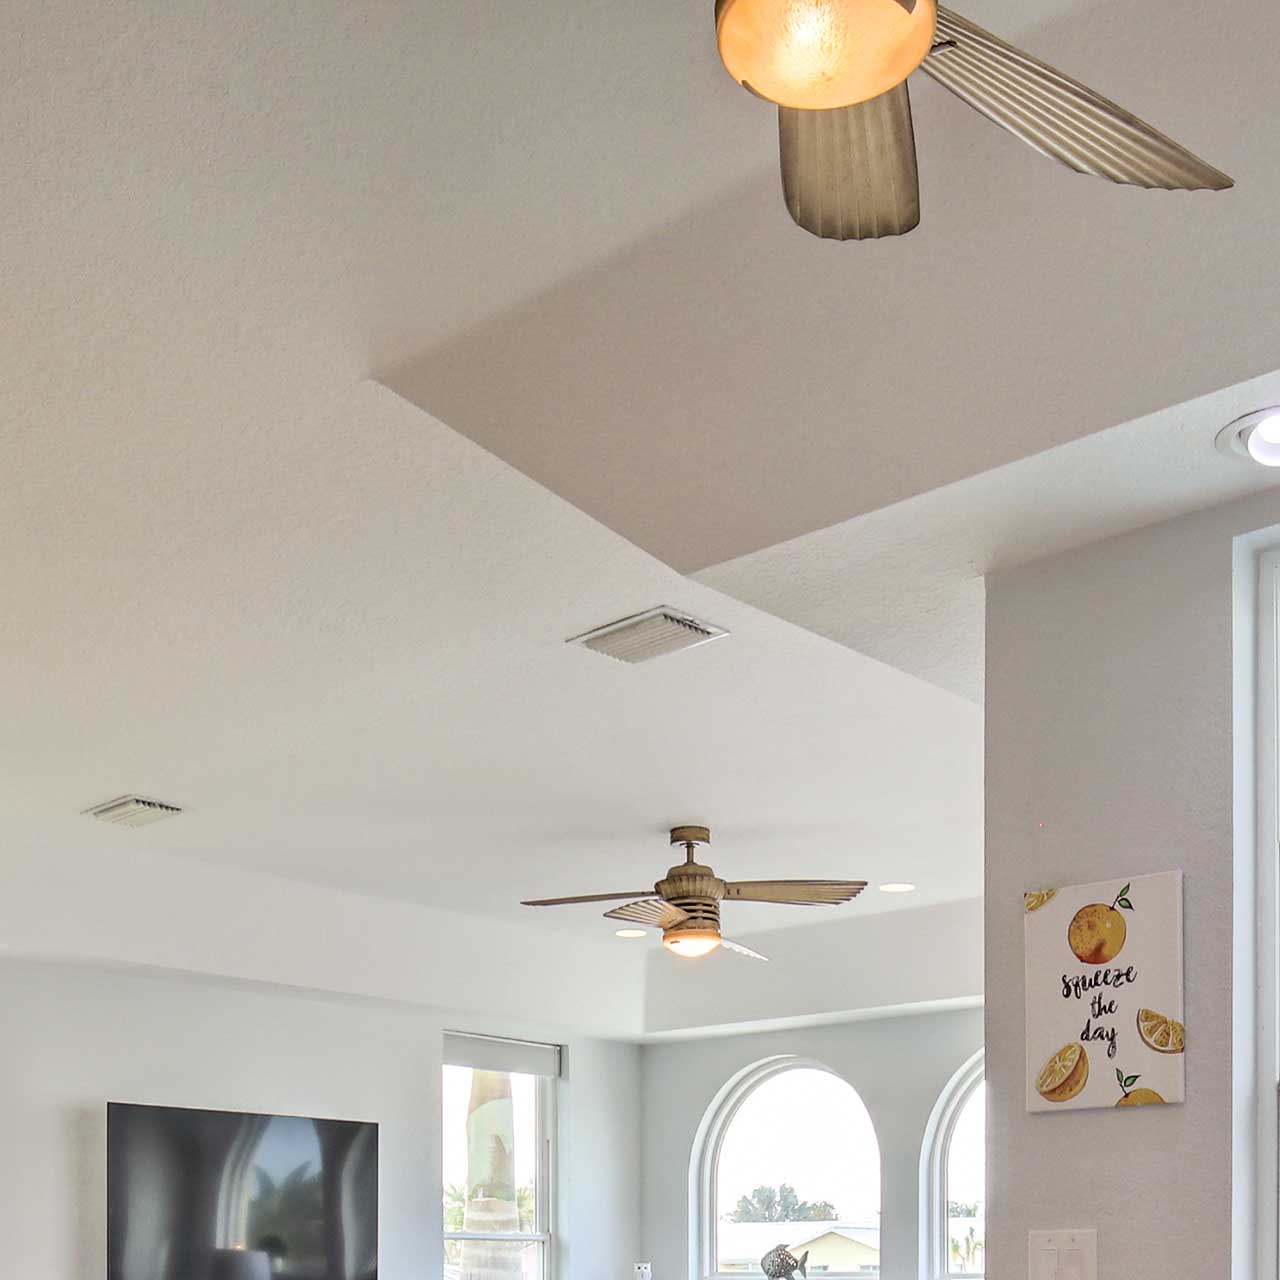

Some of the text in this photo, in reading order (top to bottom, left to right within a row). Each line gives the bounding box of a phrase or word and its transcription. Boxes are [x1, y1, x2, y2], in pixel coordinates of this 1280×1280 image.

[1061, 965, 1138, 1000] squeeze
[1090, 992, 1119, 1019] the
[1080, 1018, 1118, 1060] day
